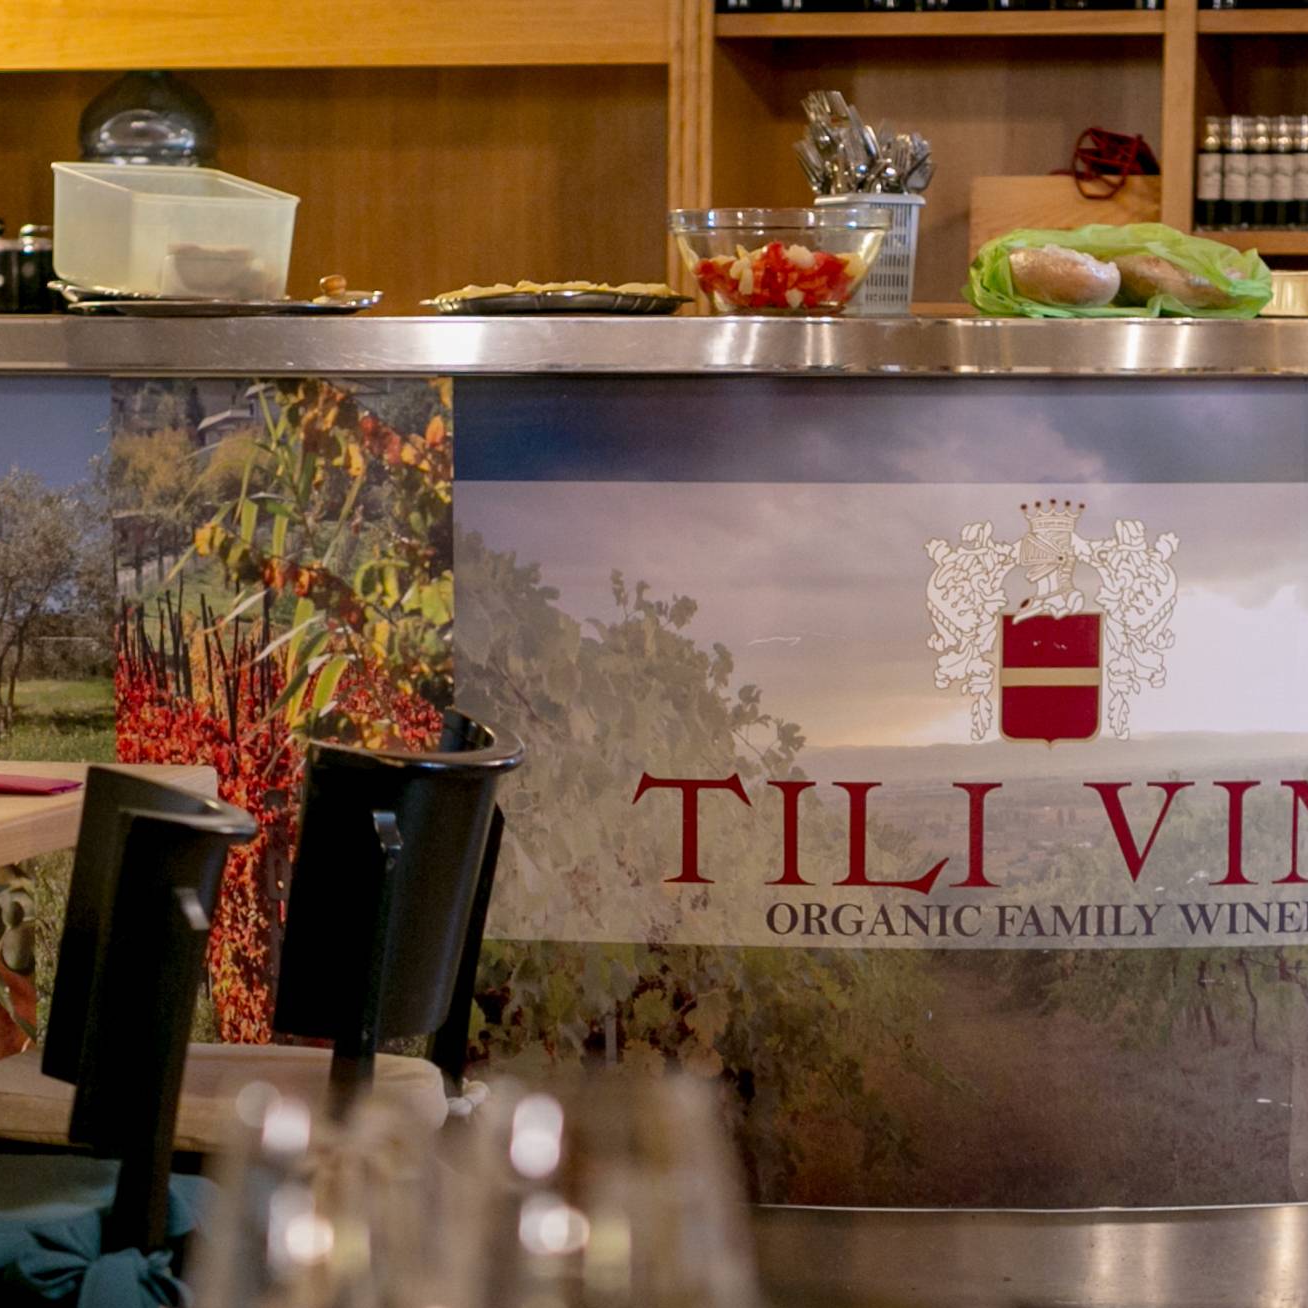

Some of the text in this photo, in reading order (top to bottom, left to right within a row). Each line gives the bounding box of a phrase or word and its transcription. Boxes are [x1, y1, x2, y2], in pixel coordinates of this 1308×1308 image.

[632, 772, 1004, 896] TILI
[765, 902, 981, 938] ORGANIC
[994, 902, 1164, 938] FAMILY
